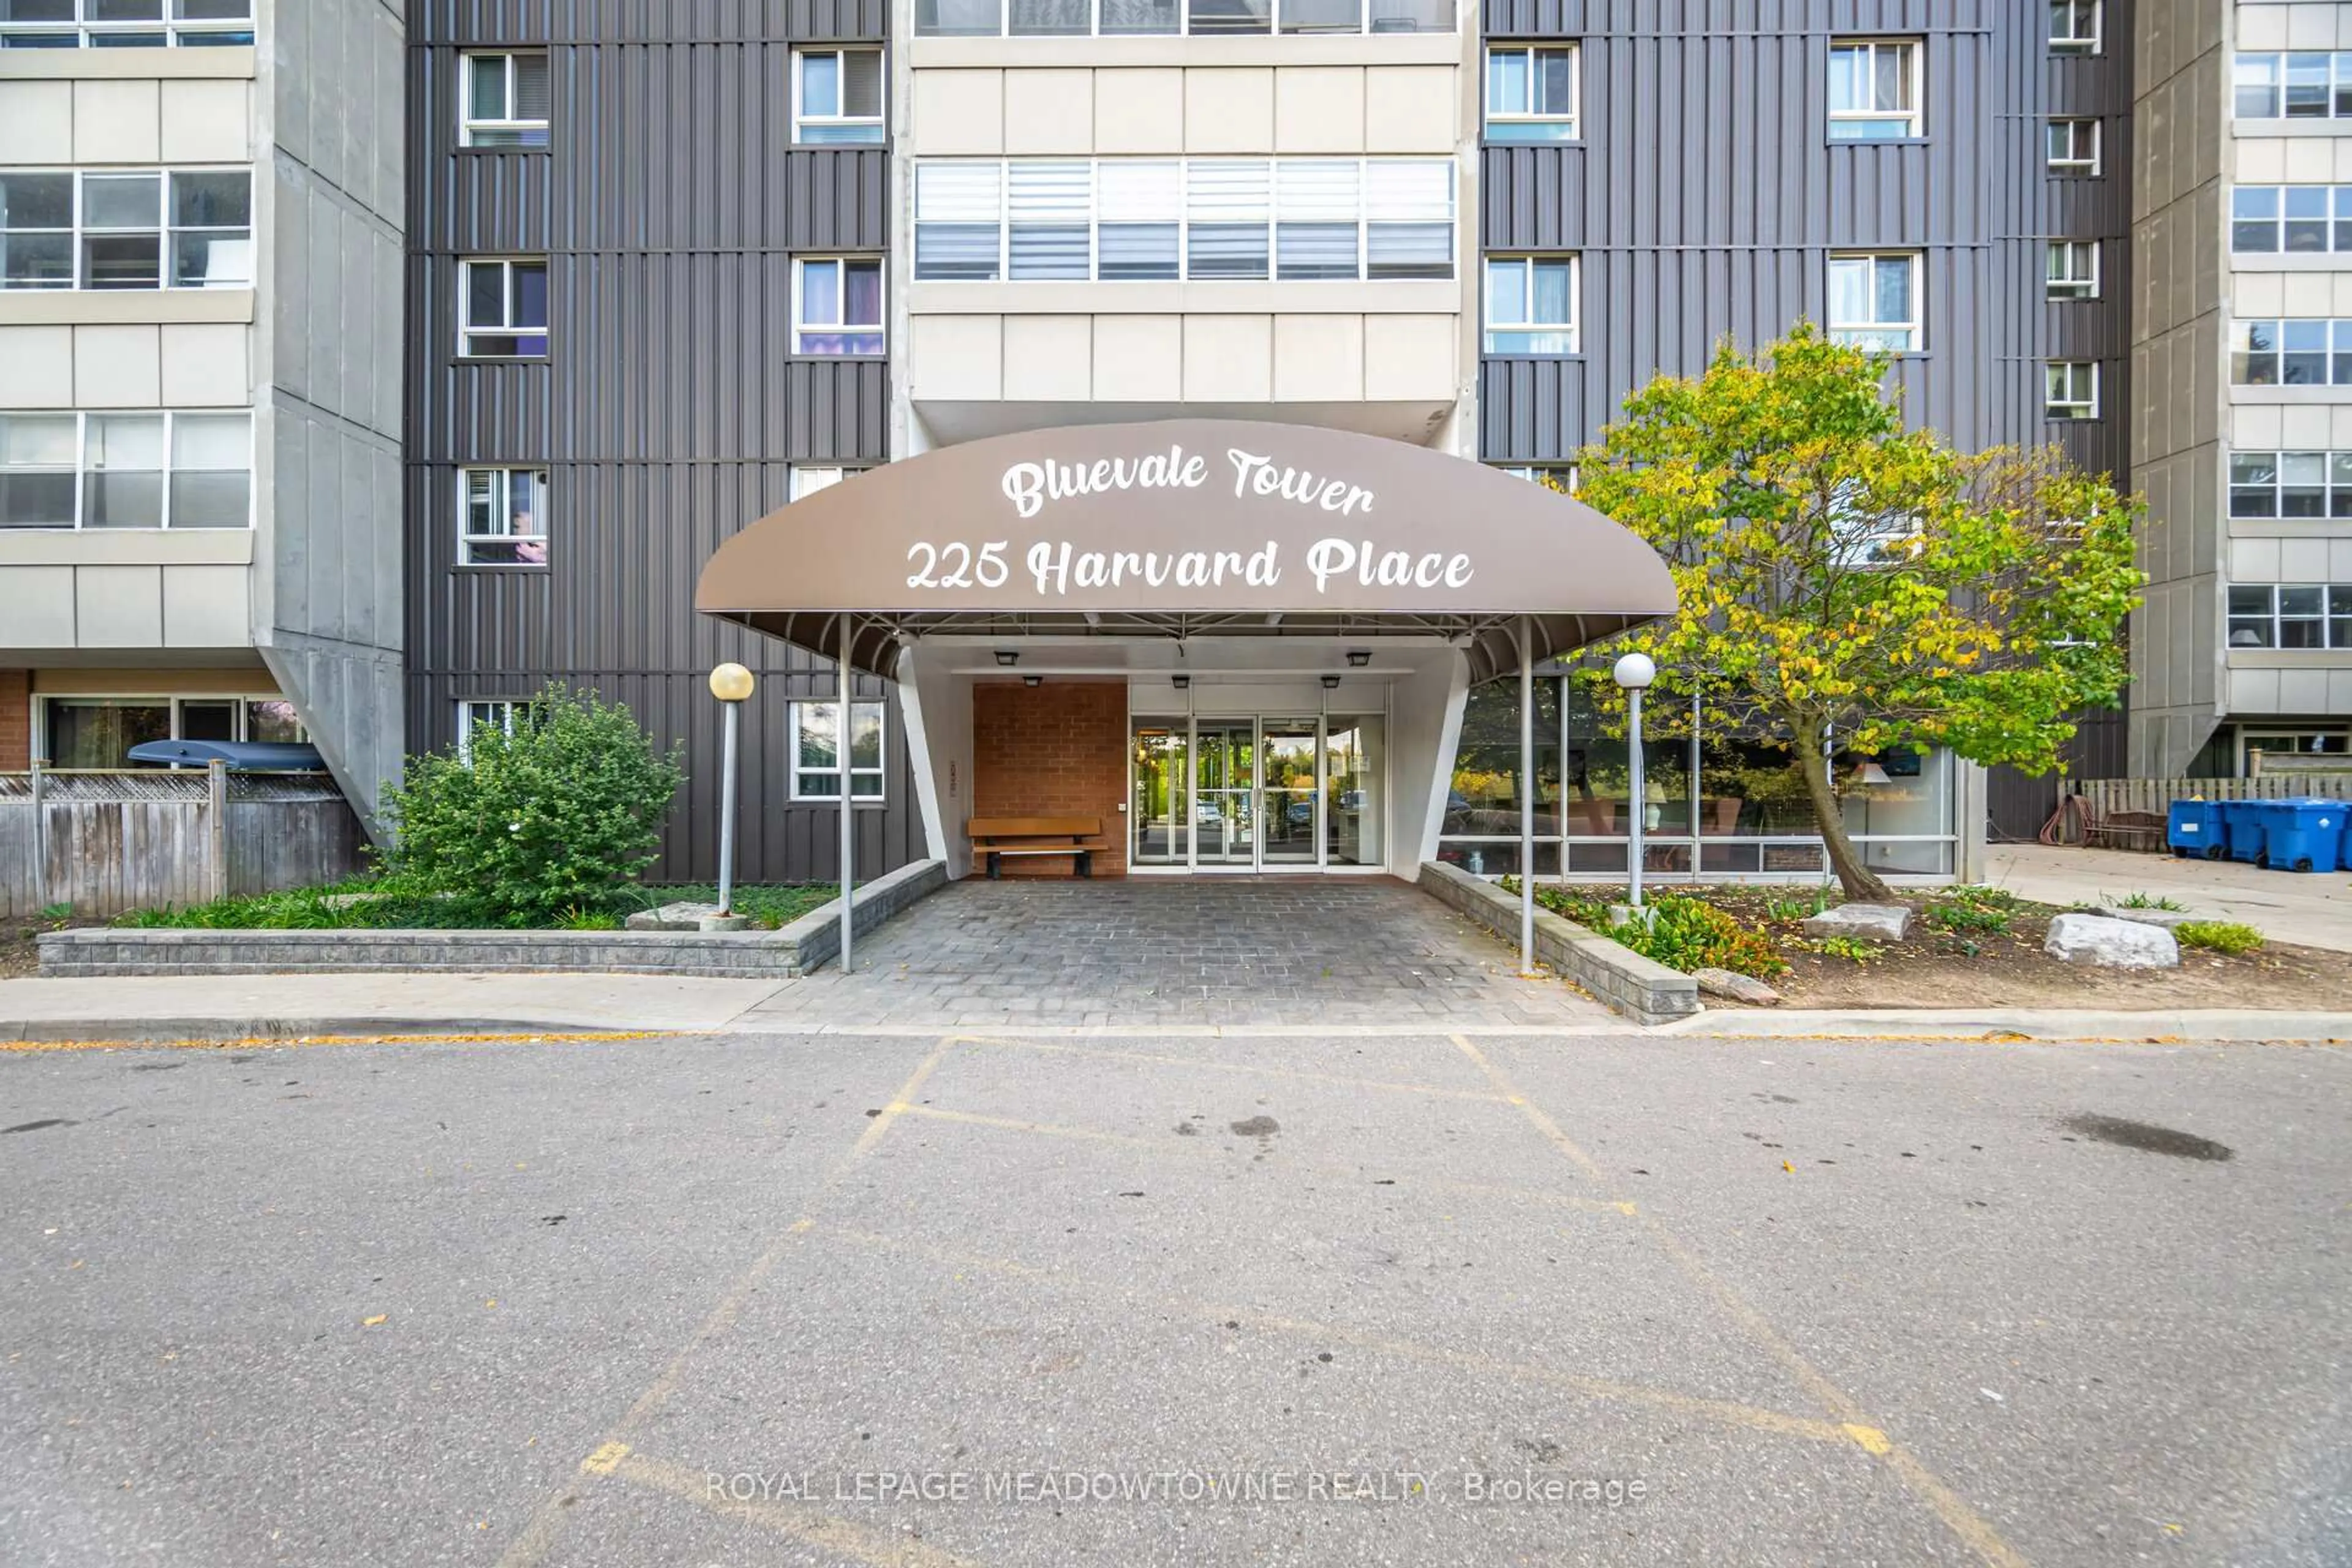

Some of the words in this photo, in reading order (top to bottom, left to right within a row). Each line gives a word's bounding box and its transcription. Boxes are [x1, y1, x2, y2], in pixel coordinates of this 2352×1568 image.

[1001, 445, 1208, 518] Bluevale
[1227, 448, 1374, 516] Tower
[907, 541, 1009, 588] 225
[1027, 541, 1281, 595] Harvard
[1306, 538, 1474, 594] Place
